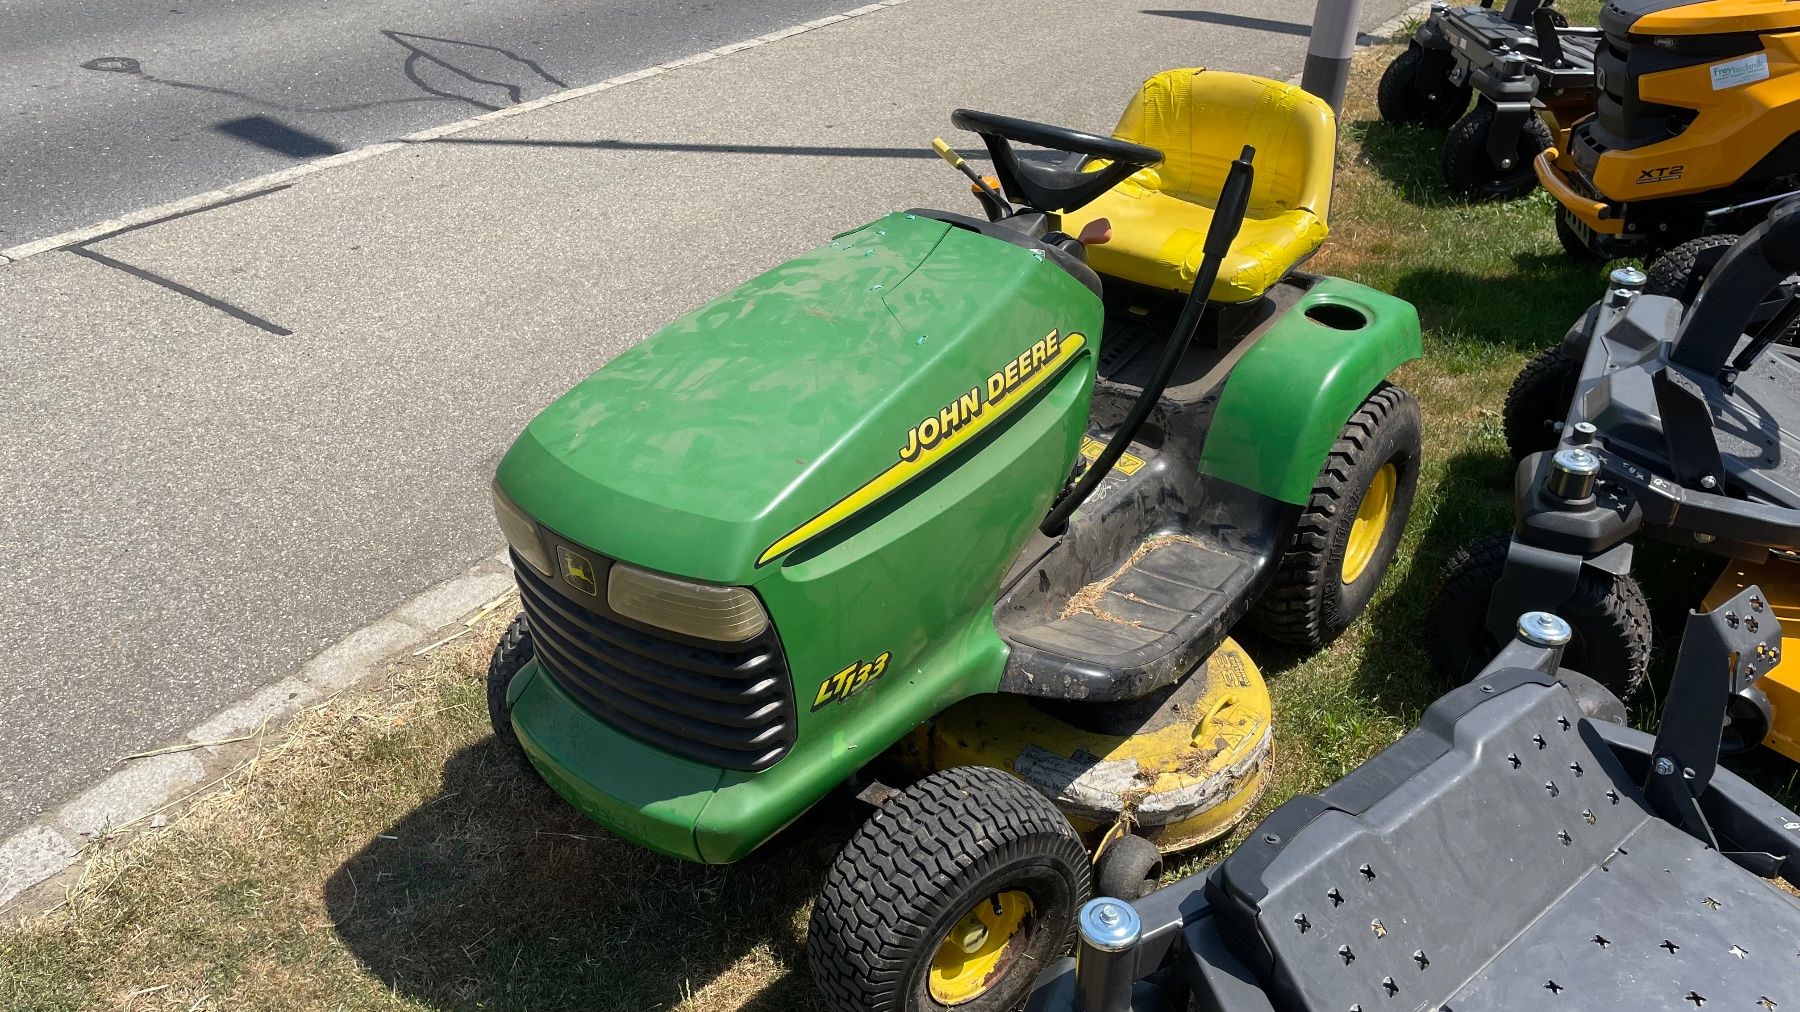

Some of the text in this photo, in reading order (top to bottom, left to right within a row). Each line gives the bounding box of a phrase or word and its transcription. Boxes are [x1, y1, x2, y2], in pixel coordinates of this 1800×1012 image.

[1639, 165, 1684, 180] XT2
[899, 328, 1061, 462] JOHN DEERE
[810, 651, 892, 713] LT133
